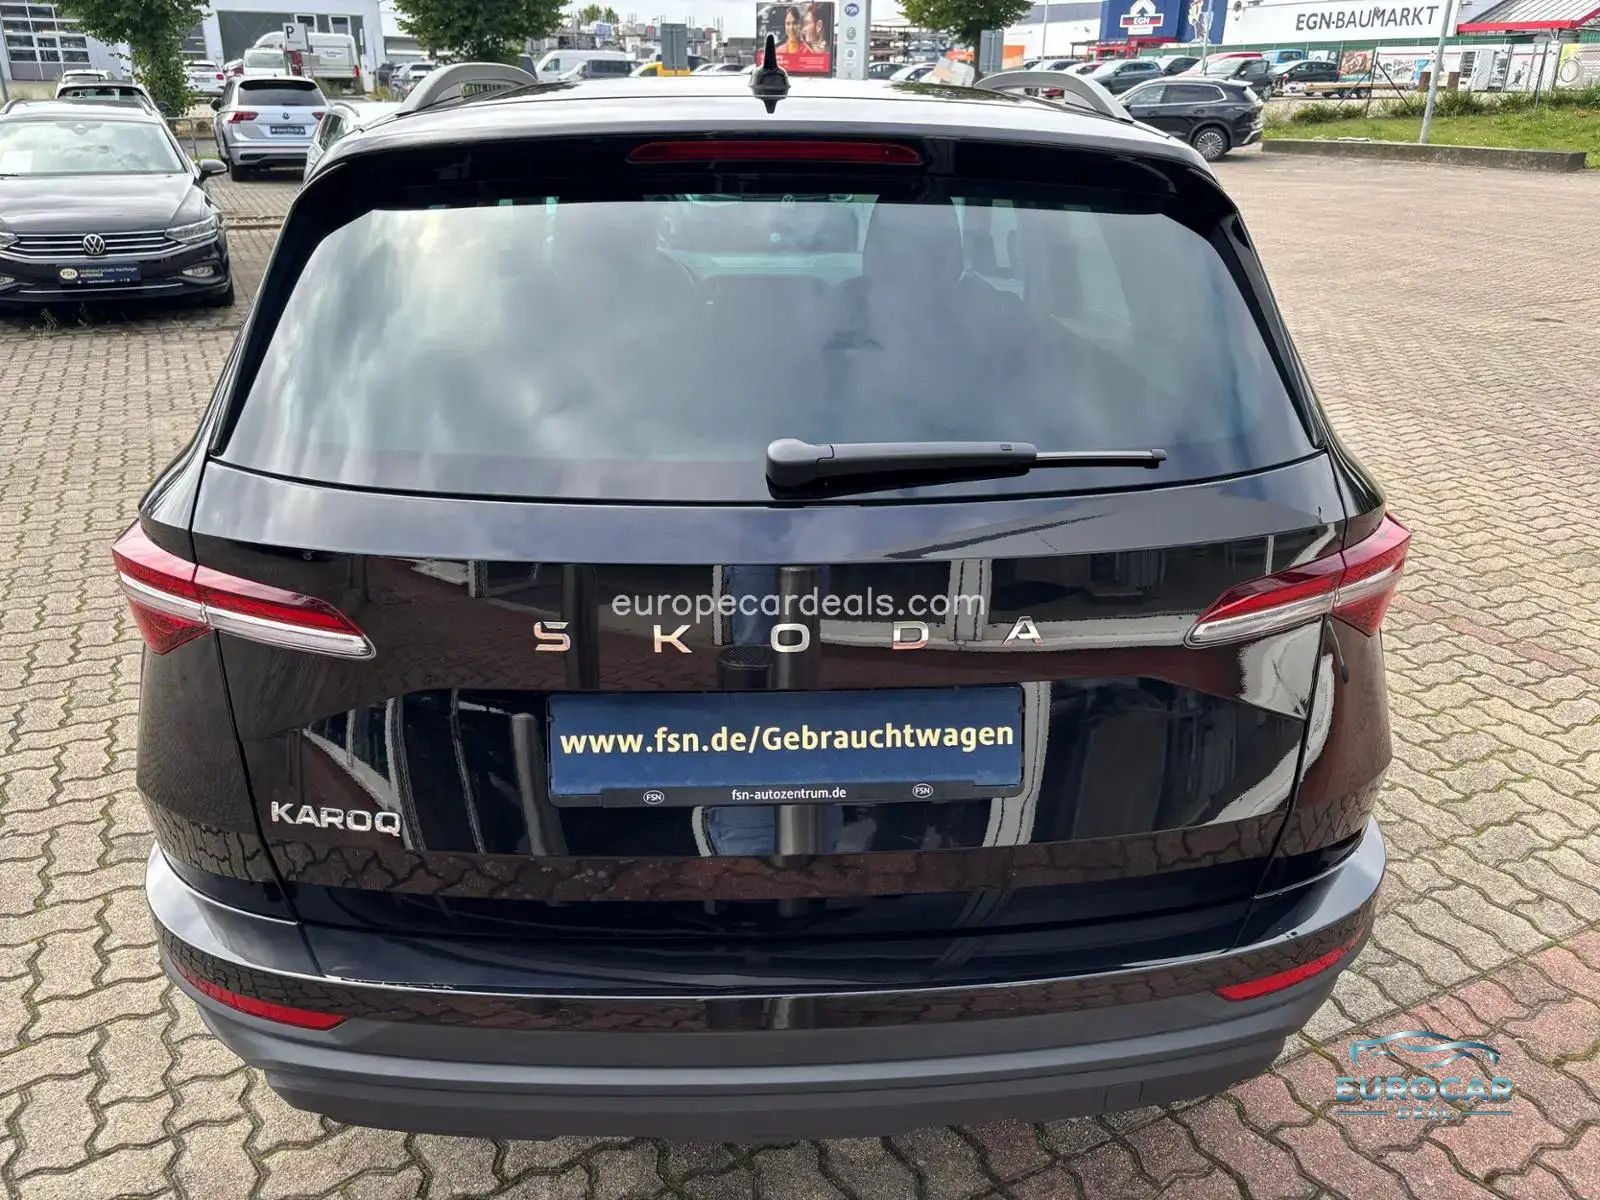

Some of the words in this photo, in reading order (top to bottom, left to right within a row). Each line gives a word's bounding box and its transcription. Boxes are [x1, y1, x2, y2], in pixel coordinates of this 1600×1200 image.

[286, 25, 294, 39] P
[1134, 17, 1150, 25] EGN
[534, 615, 1042, 653] SKODA
[560, 723, 1013, 754] www.fsn.de/Gebrauchtwagen
[731, 787, 847, 800] fsn-autozentrum.de
[271, 801, 401, 837] KAROQ
